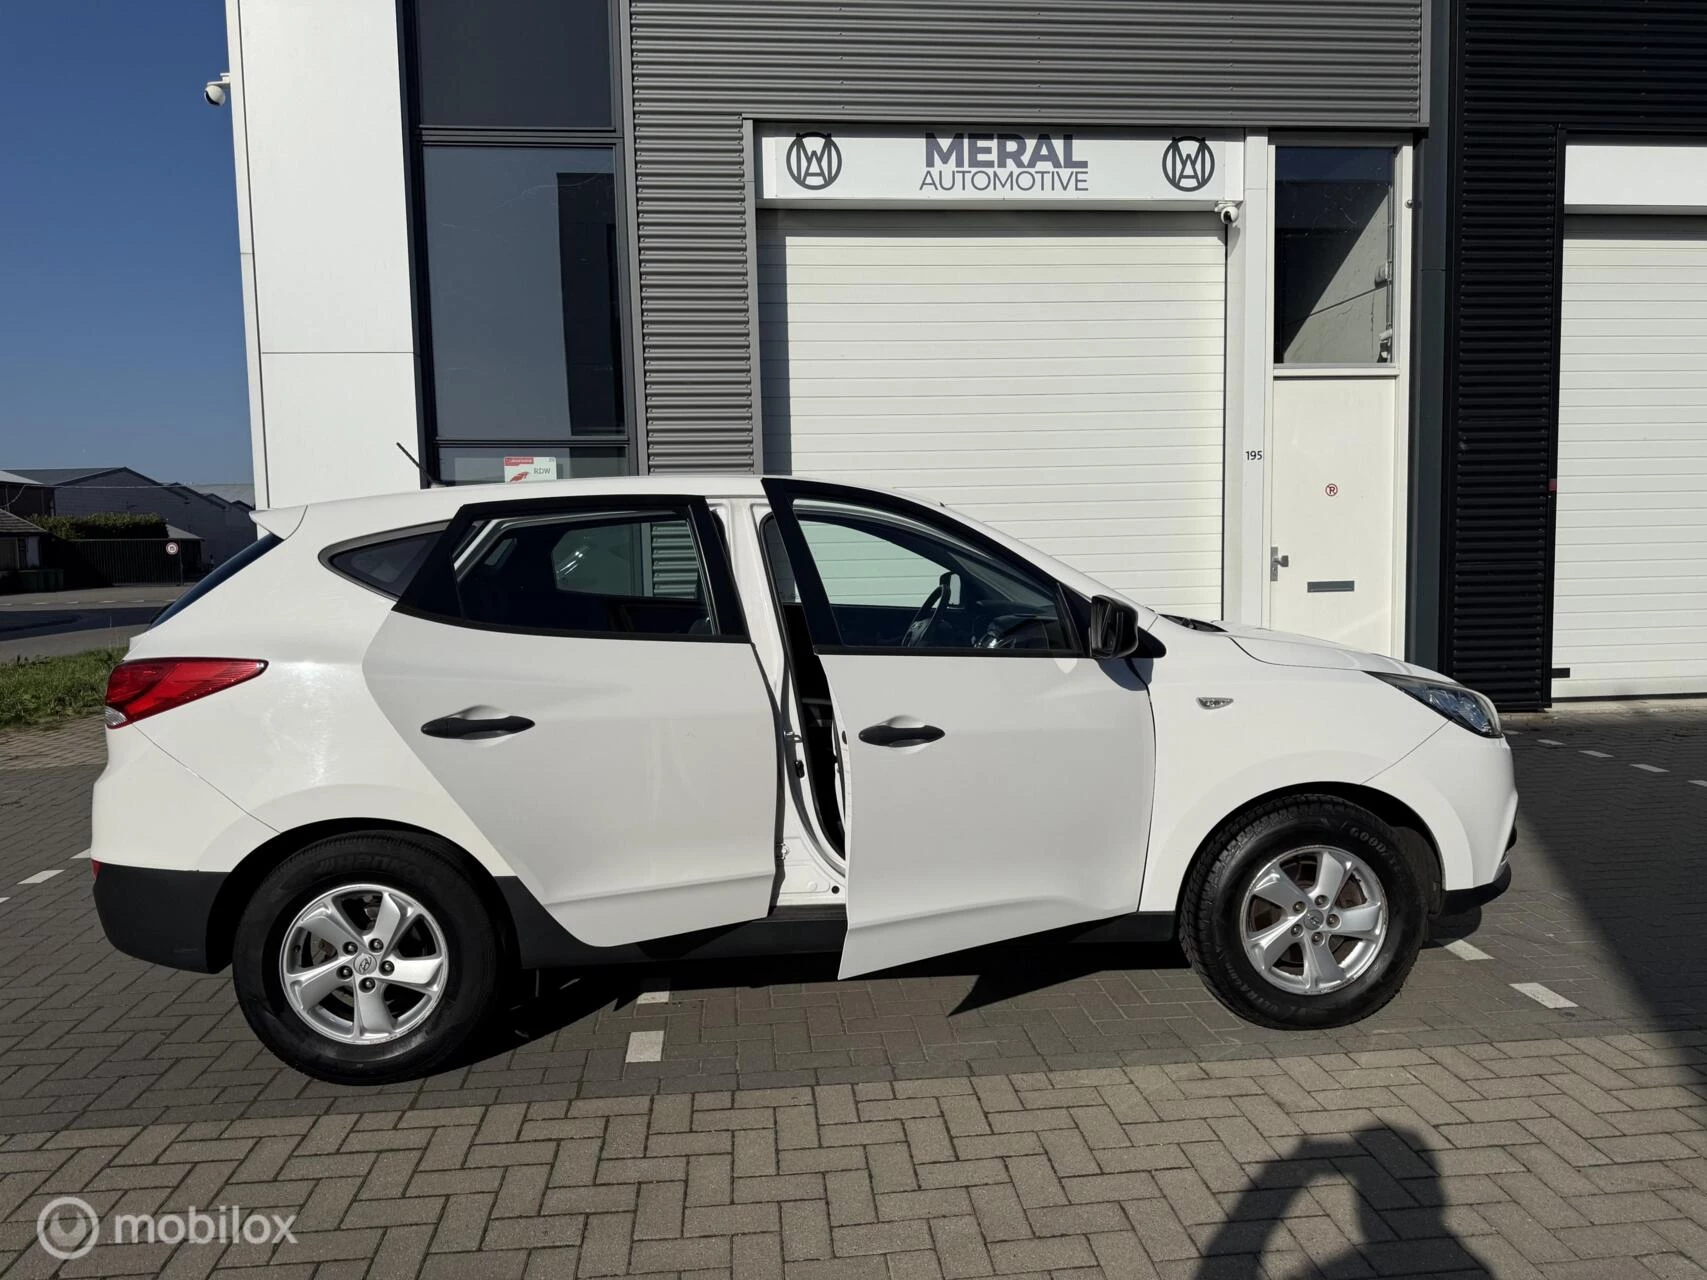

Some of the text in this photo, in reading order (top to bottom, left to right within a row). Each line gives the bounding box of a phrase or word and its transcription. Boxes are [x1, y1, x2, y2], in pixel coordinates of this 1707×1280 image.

[925, 133, 1089, 169] MERAL
[919, 170, 1089, 192] AUTOMOTIVE
[1245, 450, 1263, 461] 195
[533, 467, 551, 475] RDW
